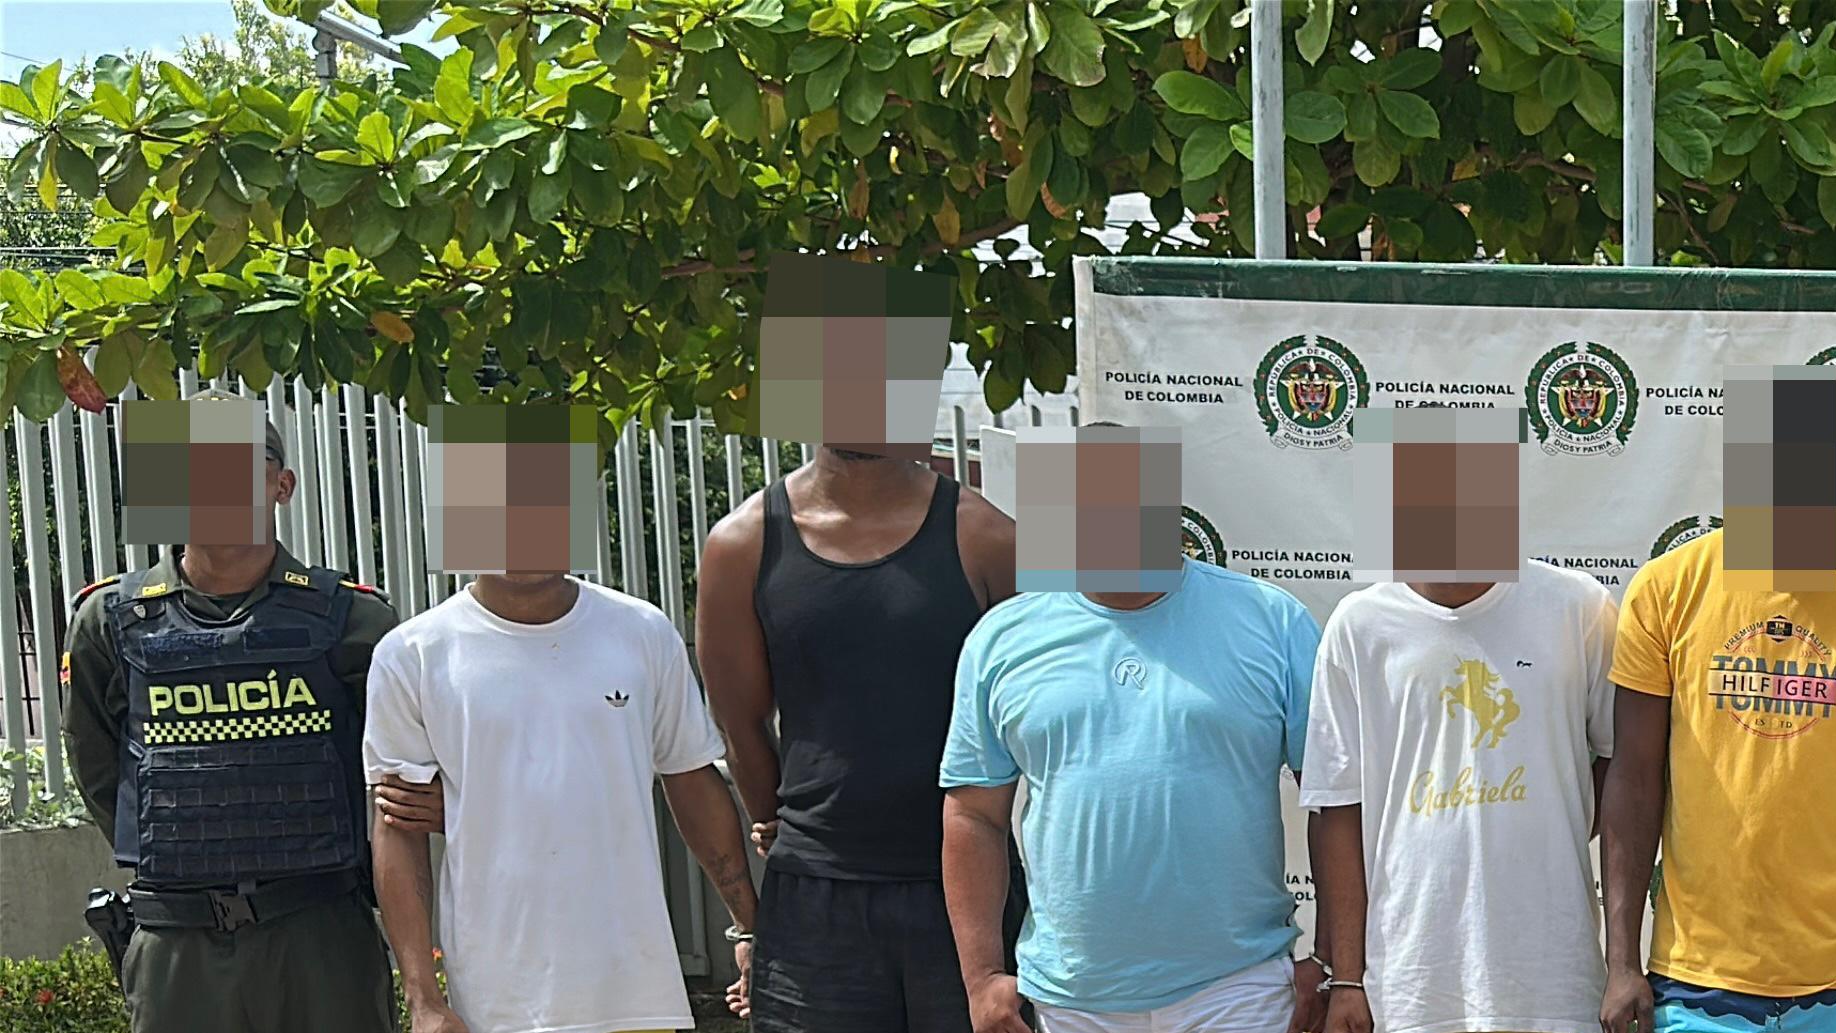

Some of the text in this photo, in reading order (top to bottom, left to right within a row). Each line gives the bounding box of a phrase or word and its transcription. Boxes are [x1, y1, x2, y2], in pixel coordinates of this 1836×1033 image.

[1306, 347, 1320, 356] DE
[1577, 354, 1590, 362] DE
[1105, 371, 1244, 387] POLICÍA NACIONAL
[1375, 381, 1515, 395] POLICÍA NACIONAL
[1646, 385, 1703, 398] POLICÍA
[1125, 390, 1224, 404] DE COLOMBIA
[1665, 406, 1683, 416] DE
[1232, 549, 1353, 563] POLICÍA NACION
[1564, 558, 1639, 569] NACIONAL
[1251, 568, 1351, 580] DE COLOMBIA
[1724, 621, 1833, 656] PREMIUM QUALITY
[148, 669, 317, 717] POLICÍA
[1409, 765, 1529, 818] Gabriela
